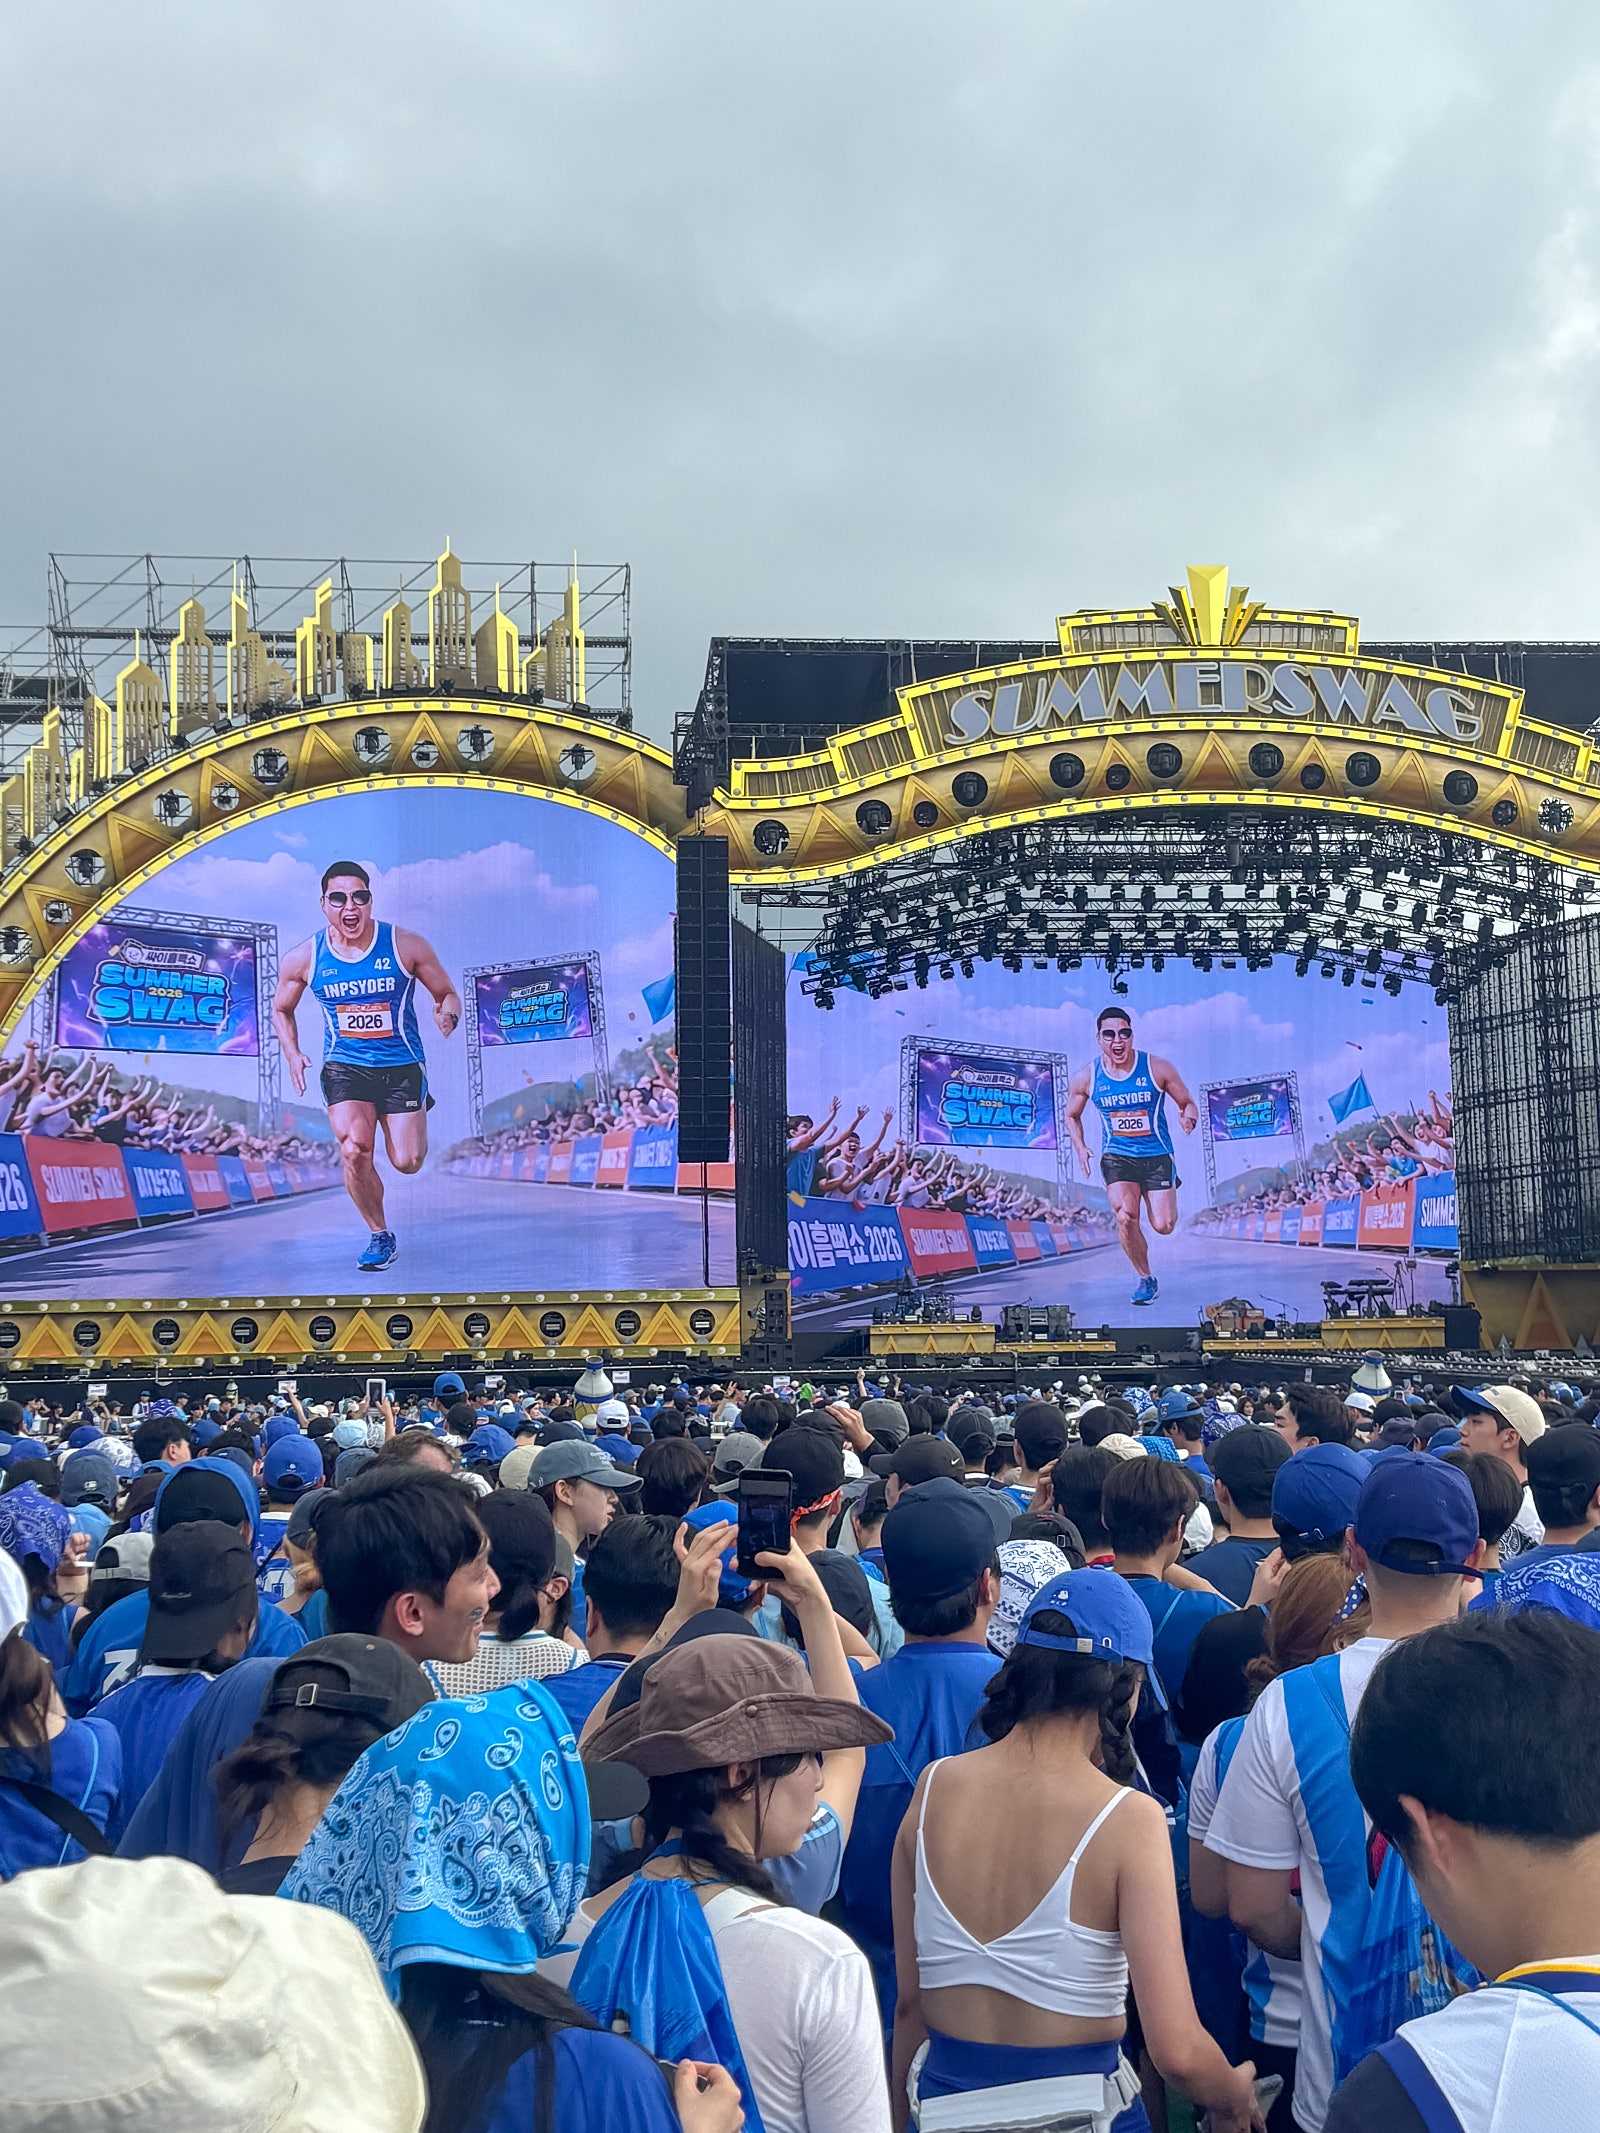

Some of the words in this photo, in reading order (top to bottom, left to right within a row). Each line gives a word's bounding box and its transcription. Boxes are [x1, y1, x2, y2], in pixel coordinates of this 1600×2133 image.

[945, 661, 1483, 744] SUMMERSWAG
[374, 957, 391, 970] 42
[100, 963, 226, 996] SUMMER
[323, 977, 396, 998] INPSYDER
[148, 987, 184, 999] 2026
[502, 991, 565, 1011] SUMMER
[95, 986, 225, 1024] SWAG
[500, 1003, 563, 1027] SWAG
[347, 1014, 383, 1029] 2026
[1135, 1076, 1148, 1087] 42
[945, 1082, 1034, 1106] SUMMER
[1100, 1091, 1152, 1107] INPSYDER
[942, 1099, 1033, 1127] SWAG
[1226, 1110, 1272, 1127] SWAG
[1118, 1118, 1144, 1130] 2026
